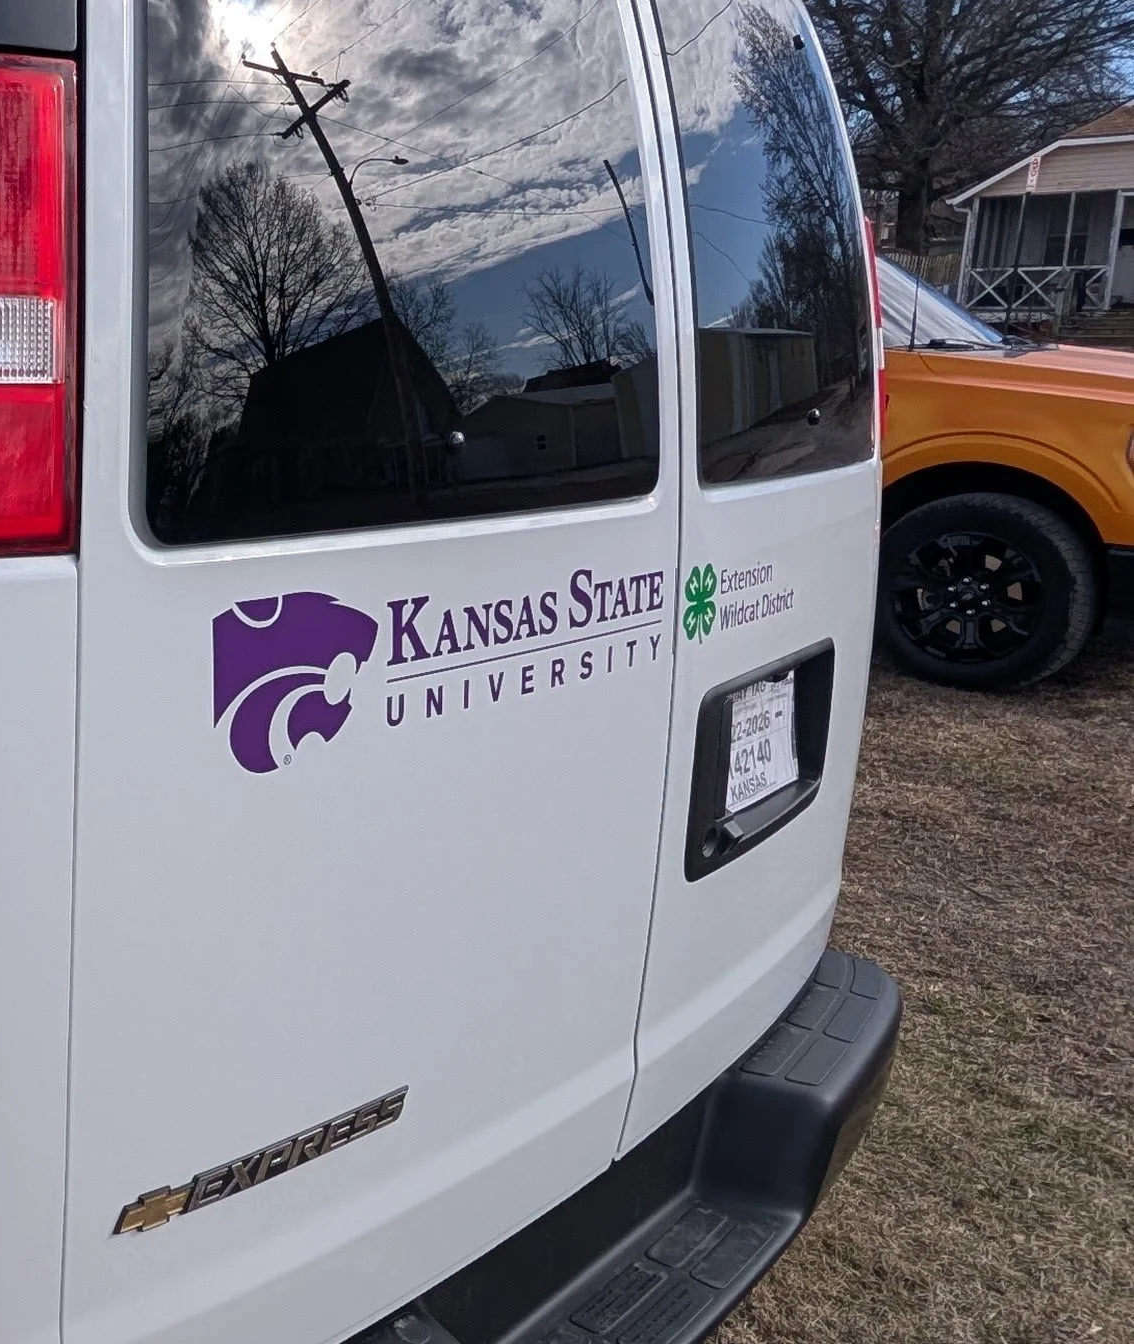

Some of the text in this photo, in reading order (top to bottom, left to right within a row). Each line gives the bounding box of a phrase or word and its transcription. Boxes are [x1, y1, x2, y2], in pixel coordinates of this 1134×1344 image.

[719, 588, 795, 631] Wildcat District
[720, 561, 773, 595] Extension
[386, 568, 664, 667] KANSAS STATE
[386, 633, 662, 727] UNIVERSITY
[730, 771, 768, 803] KANSAS
[187, 1088, 407, 1213] EXPRESS
